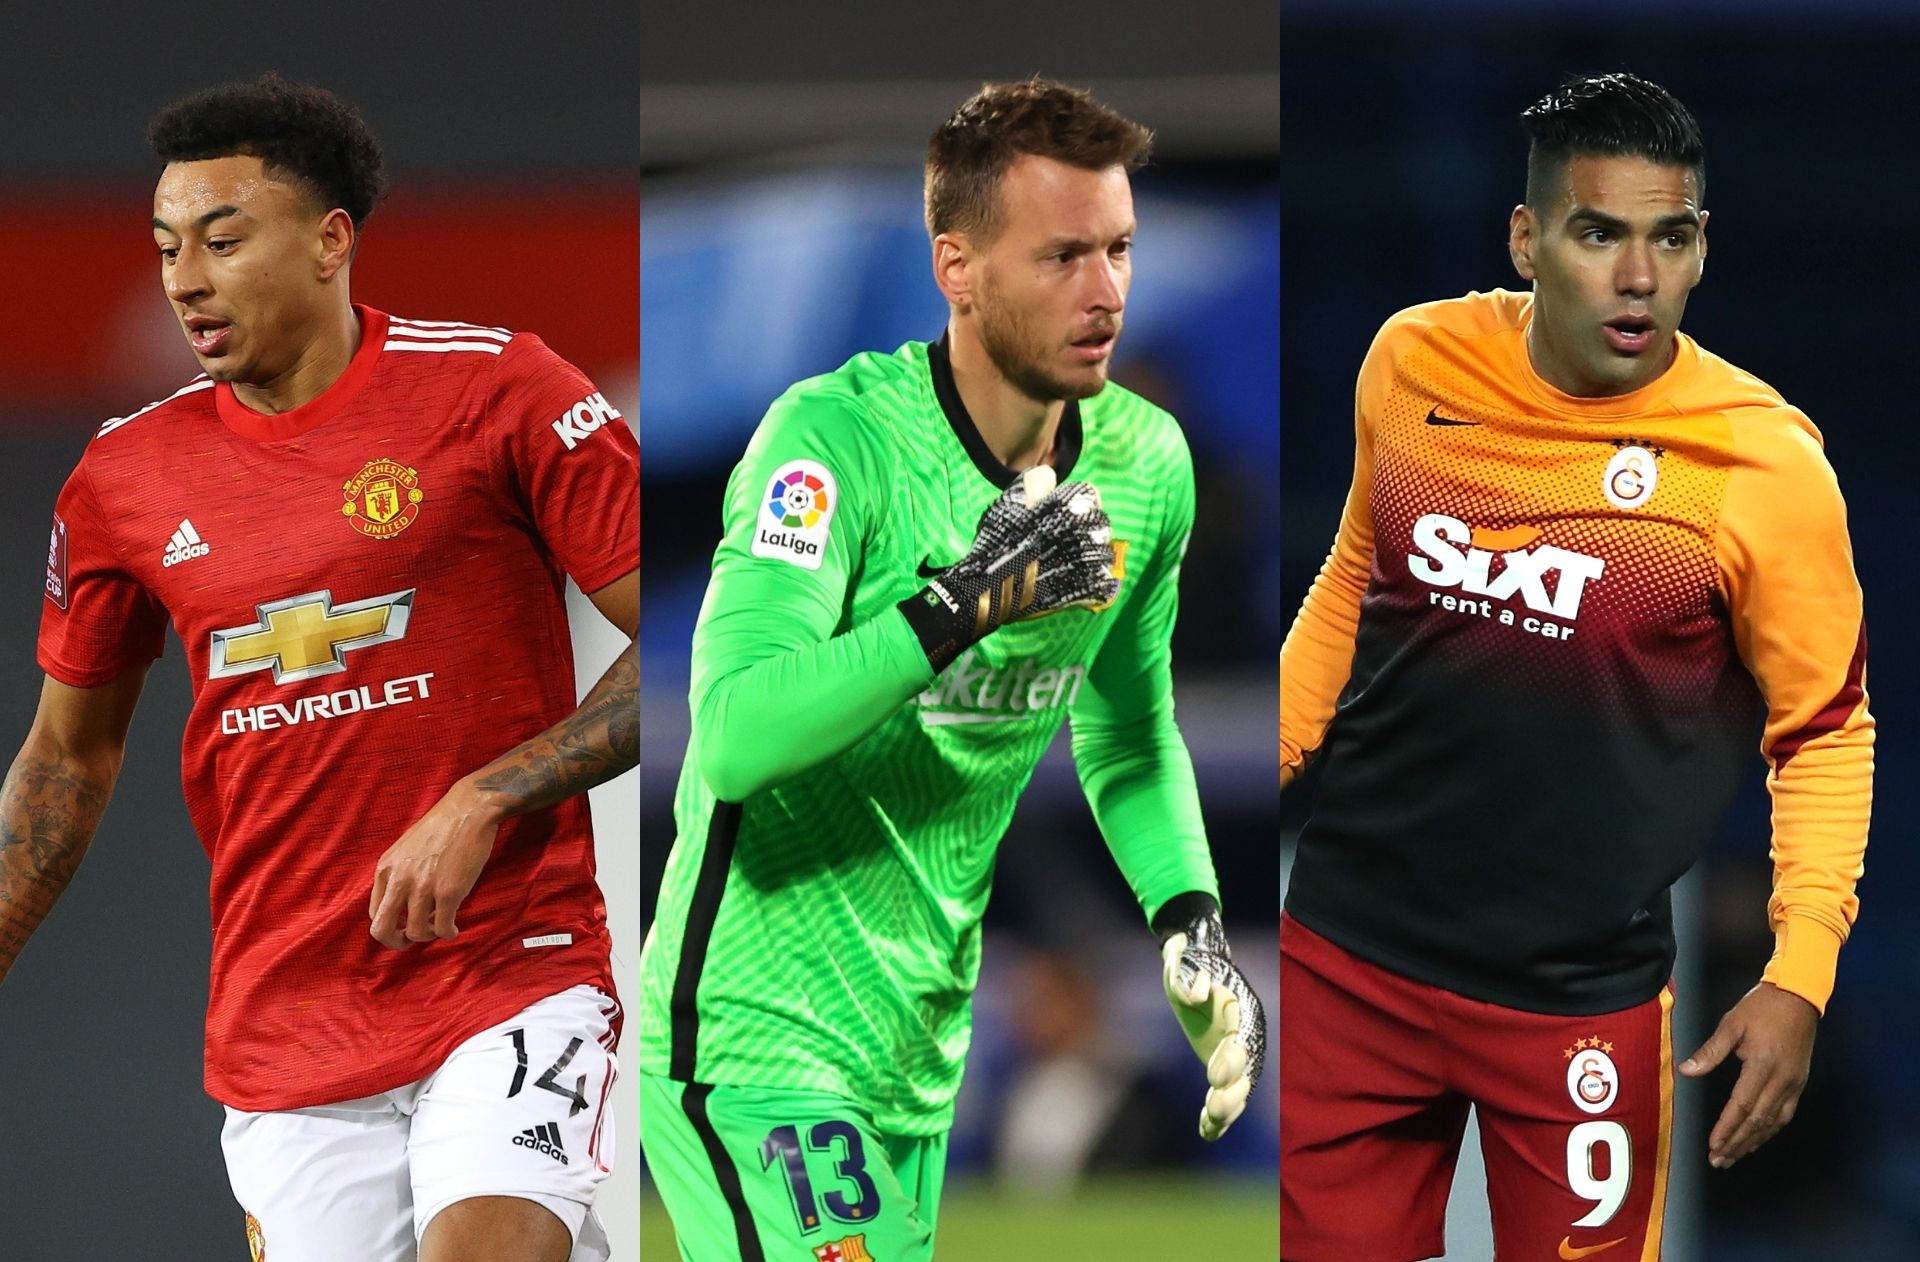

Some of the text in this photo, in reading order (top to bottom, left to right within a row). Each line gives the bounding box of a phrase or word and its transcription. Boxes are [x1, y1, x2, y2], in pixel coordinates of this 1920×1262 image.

[349, 464, 413, 496] MANCHESTER
[363, 516, 409, 534] UNITED
[760, 529, 818, 555] LaLiga
[162, 543, 210, 568] adidas
[46, 578, 62, 598] CUP
[1429, 591, 1575, 641] rent a car
[904, 649, 1084, 712] akuten
[222, 672, 434, 735] CHEVROLET
[500, 1028, 590, 1119] 14
[512, 1134, 569, 1166] adidas
[757, 1119, 882, 1237] 13
[1566, 1119, 1633, 1228] 9
